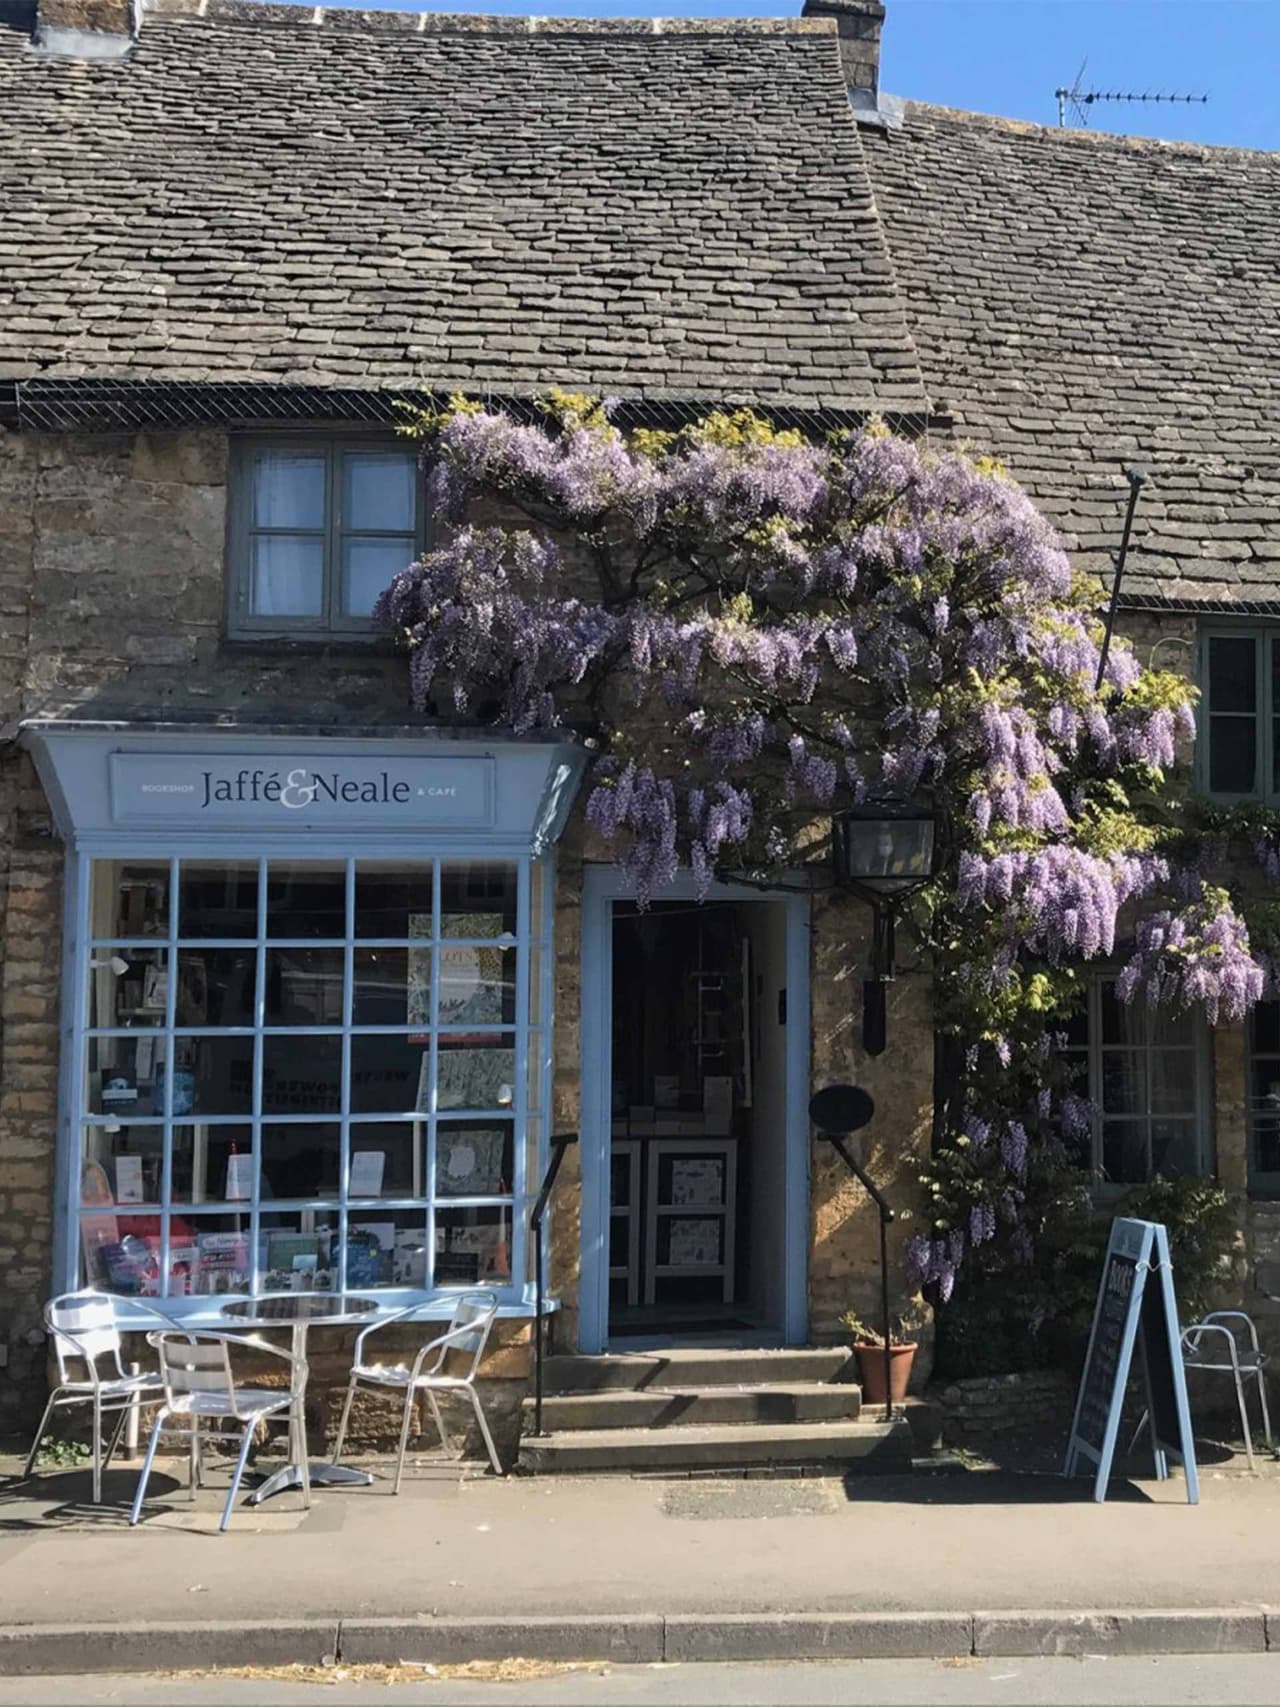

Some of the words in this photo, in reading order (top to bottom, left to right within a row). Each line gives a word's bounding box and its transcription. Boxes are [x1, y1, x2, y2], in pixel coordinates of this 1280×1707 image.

[141, 784, 195, 793] BOOKSHOP
[201, 770, 281, 808] Jaffé
[311, 773, 410, 803] Neale
[427, 785, 457, 797] CAFÉ
